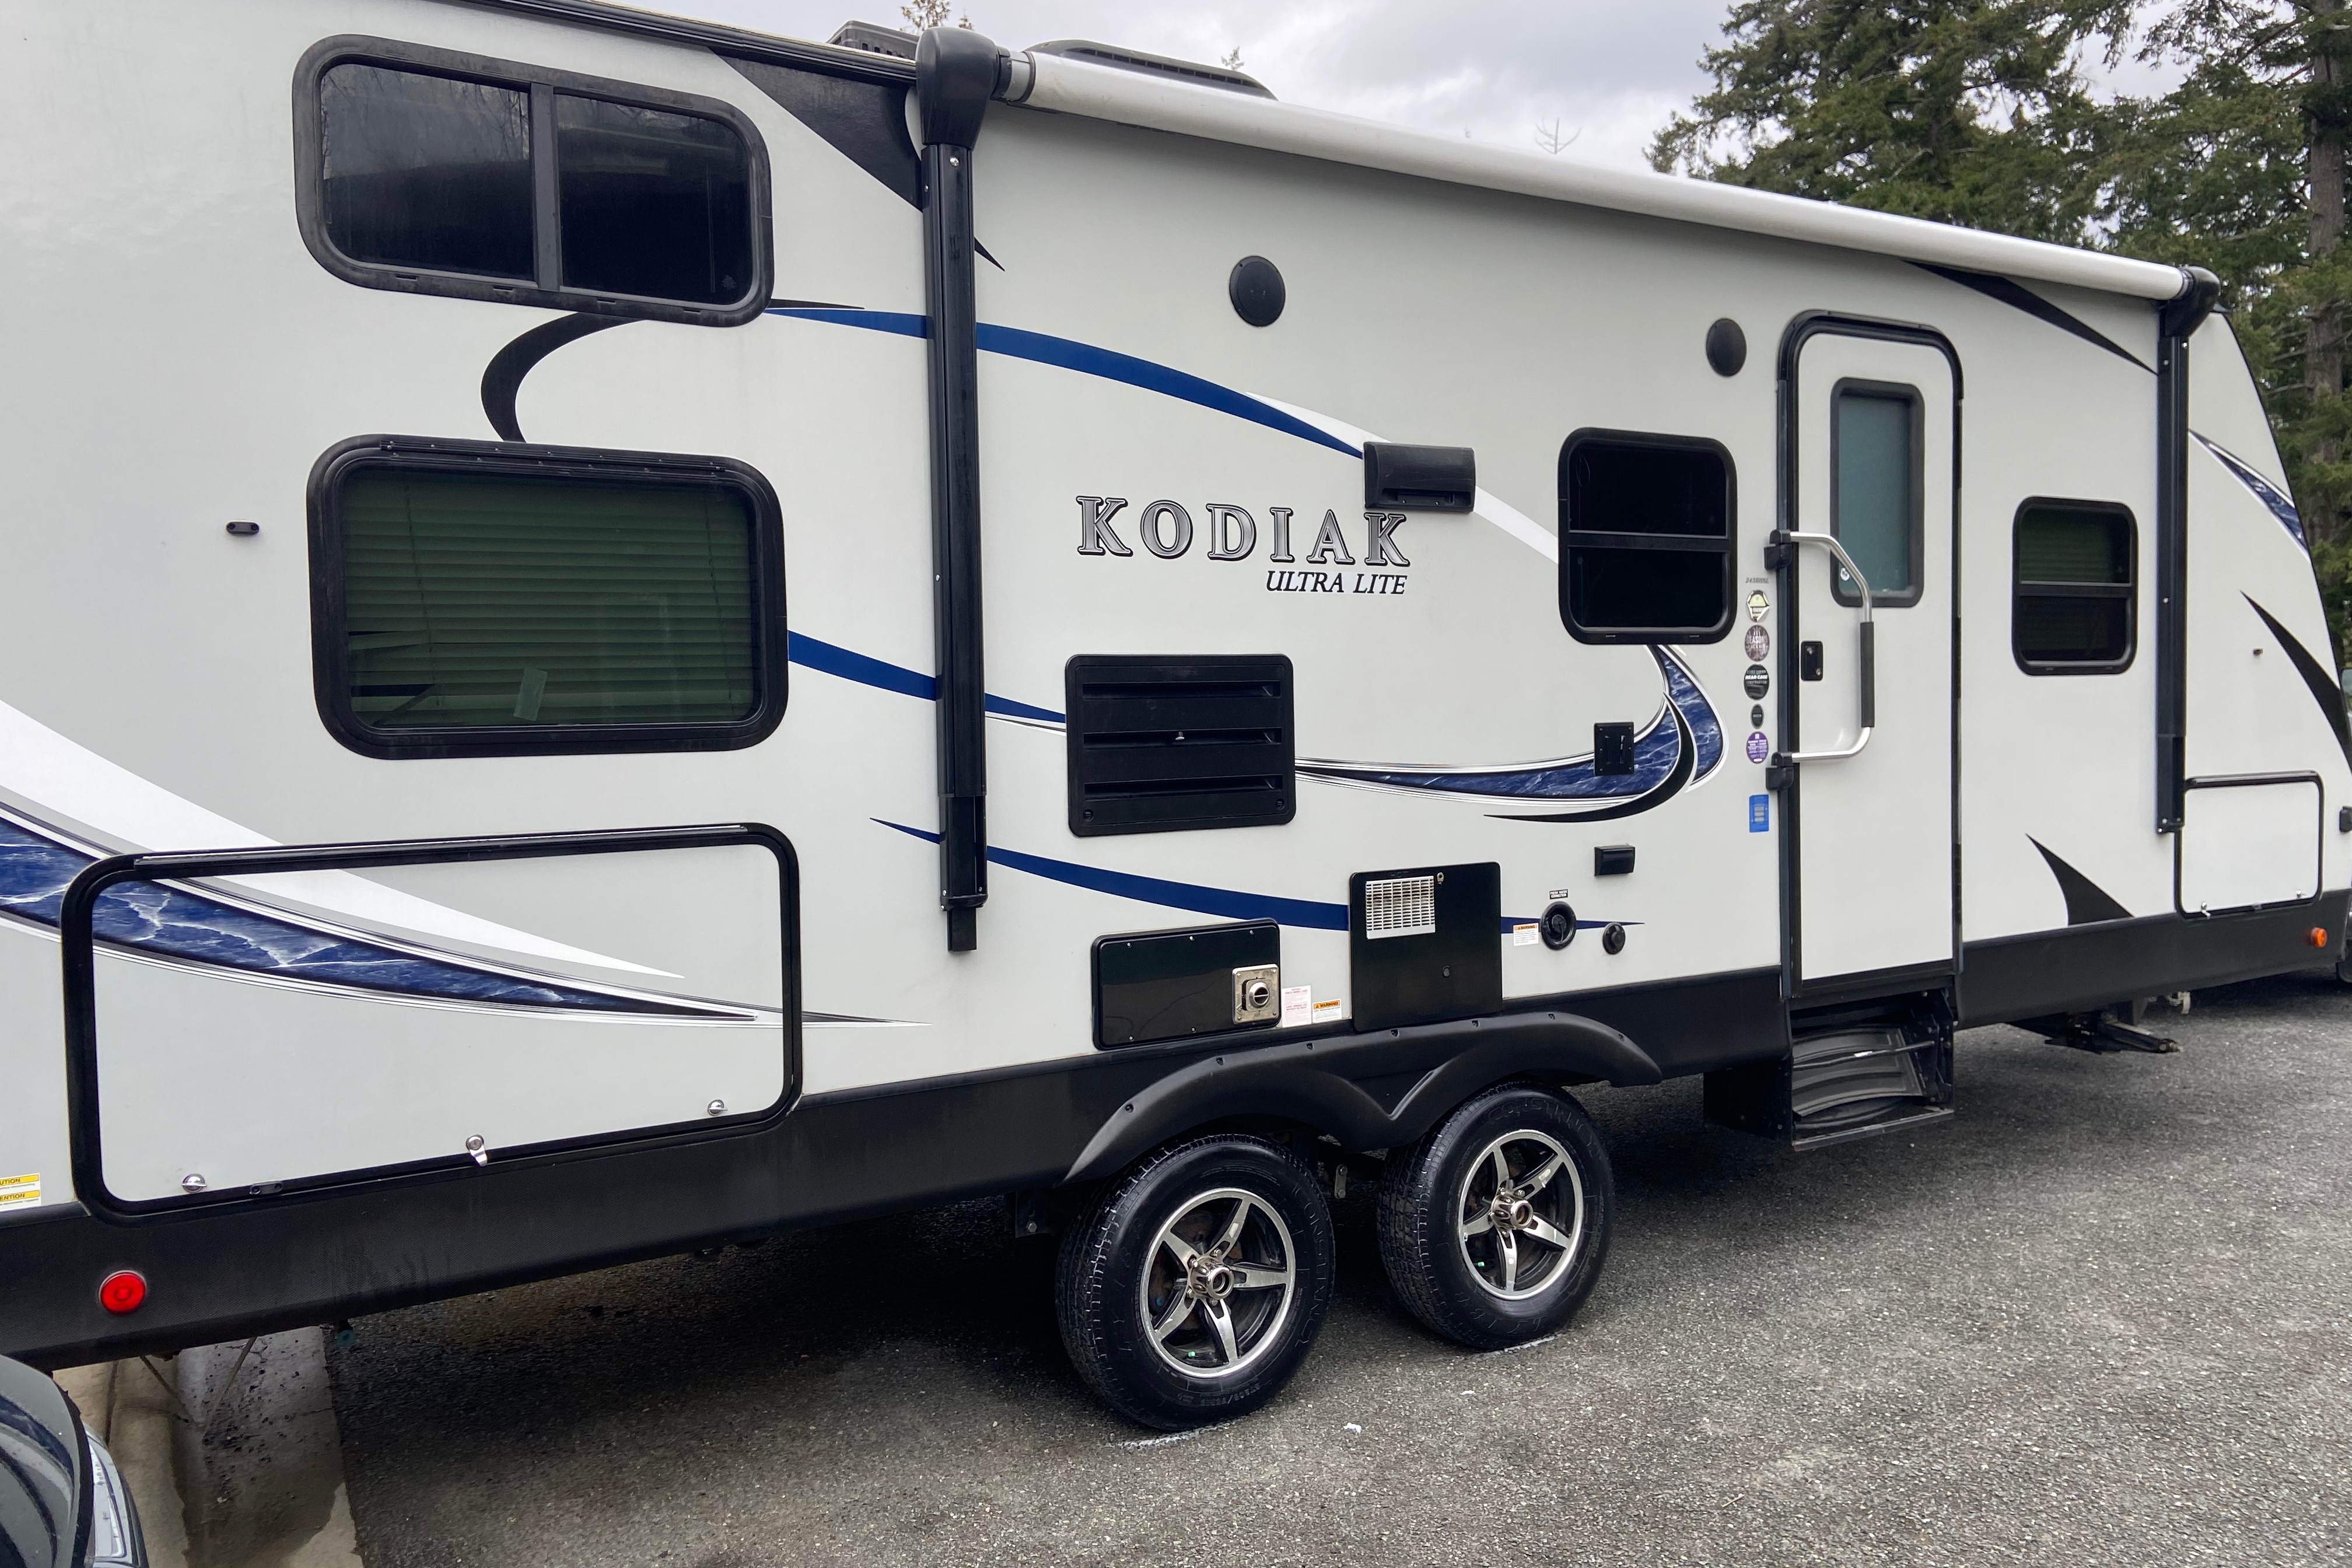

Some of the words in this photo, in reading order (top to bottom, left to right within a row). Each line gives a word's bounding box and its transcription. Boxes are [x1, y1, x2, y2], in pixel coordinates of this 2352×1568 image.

[1076, 495, 1410, 568] KODIAK
[1266, 570, 1344, 593] ULTRA
[1352, 573, 1408, 595] LITE
